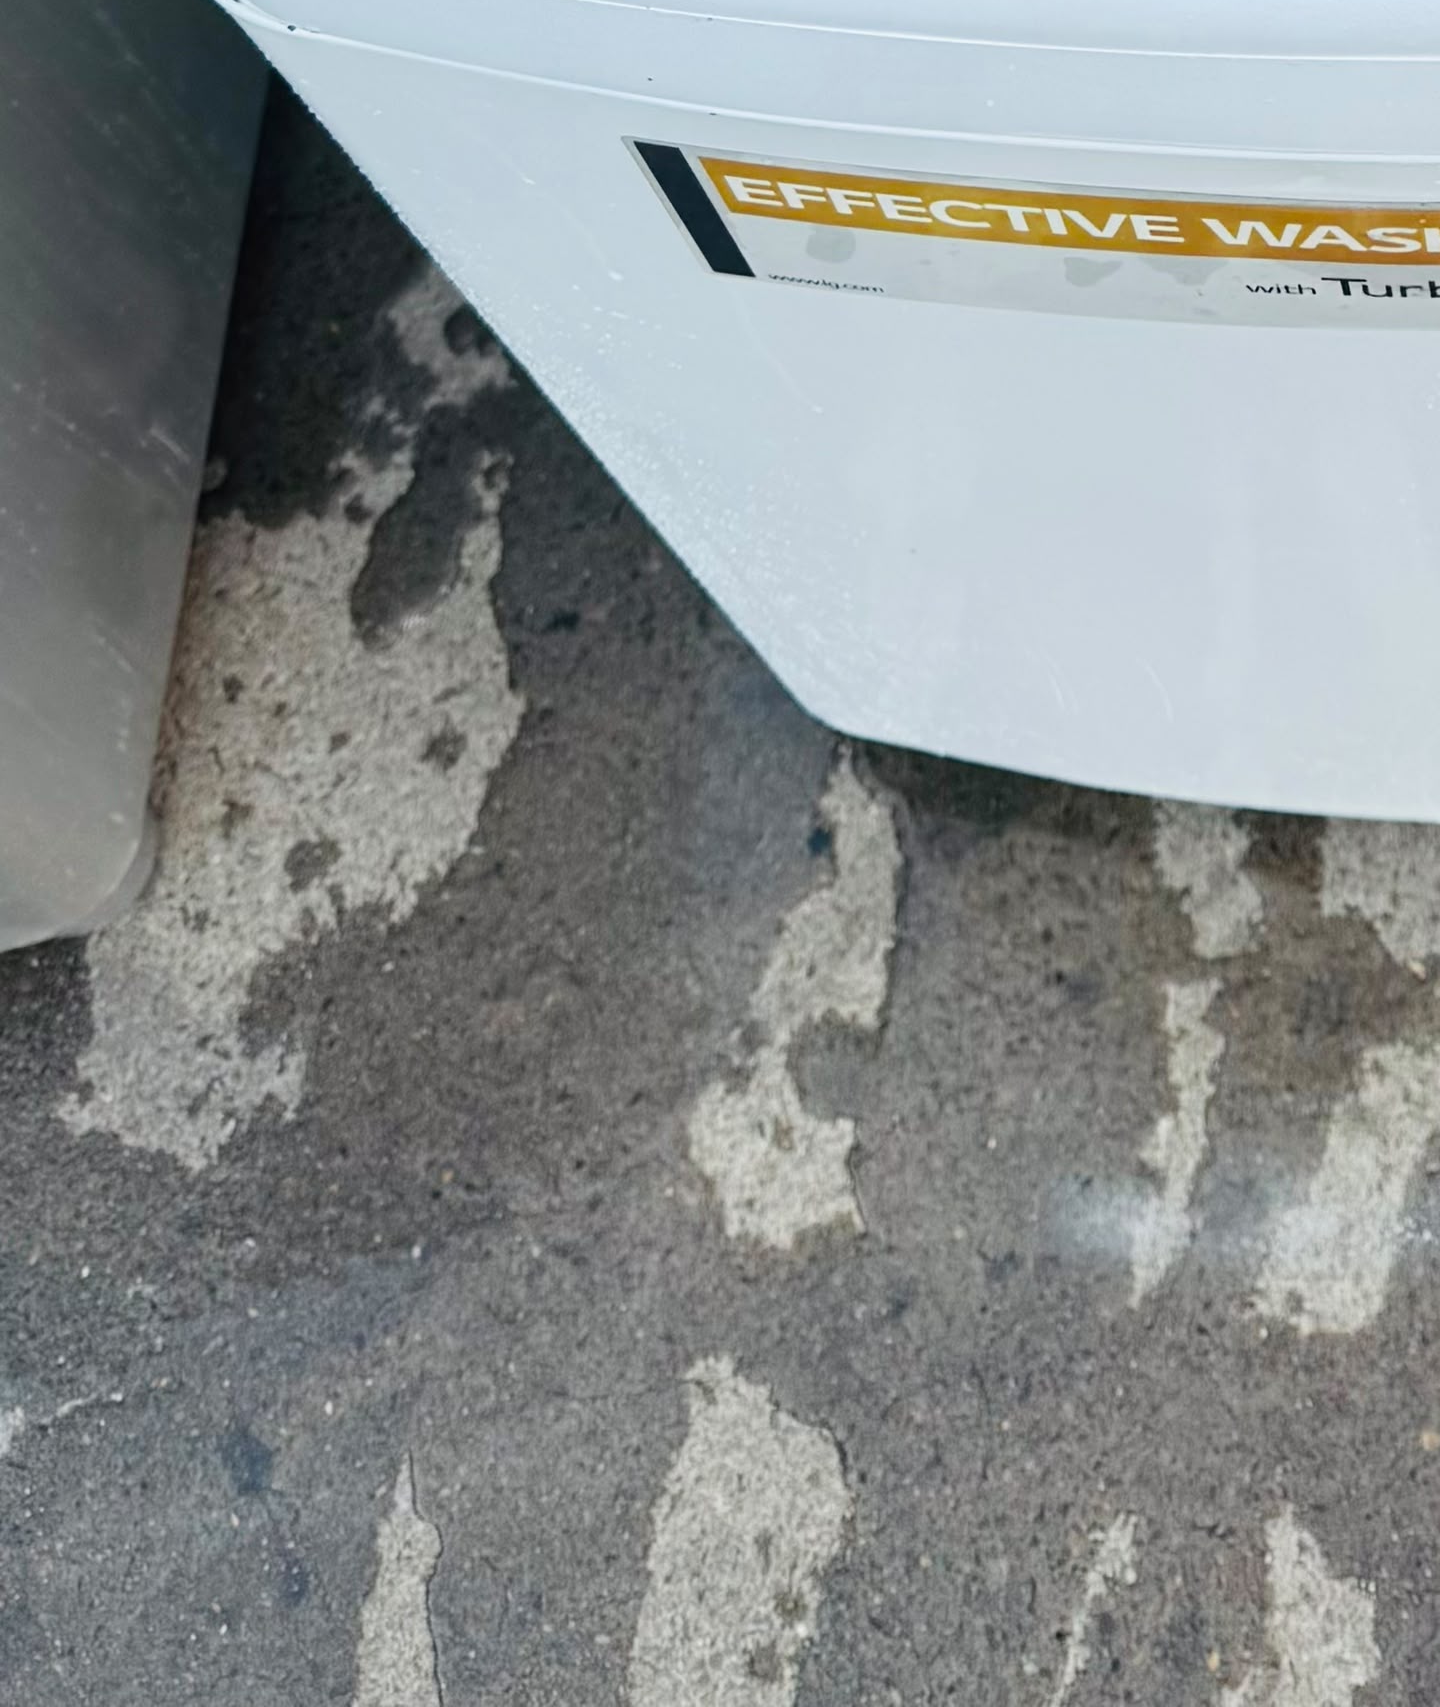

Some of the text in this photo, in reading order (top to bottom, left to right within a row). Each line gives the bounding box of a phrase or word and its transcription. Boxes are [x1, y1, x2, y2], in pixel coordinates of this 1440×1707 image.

[723, 174, 1185, 244] EFFECTIVE
[768, 274, 884, 293] www.lg.com
[1246, 282, 1317, 296] with
